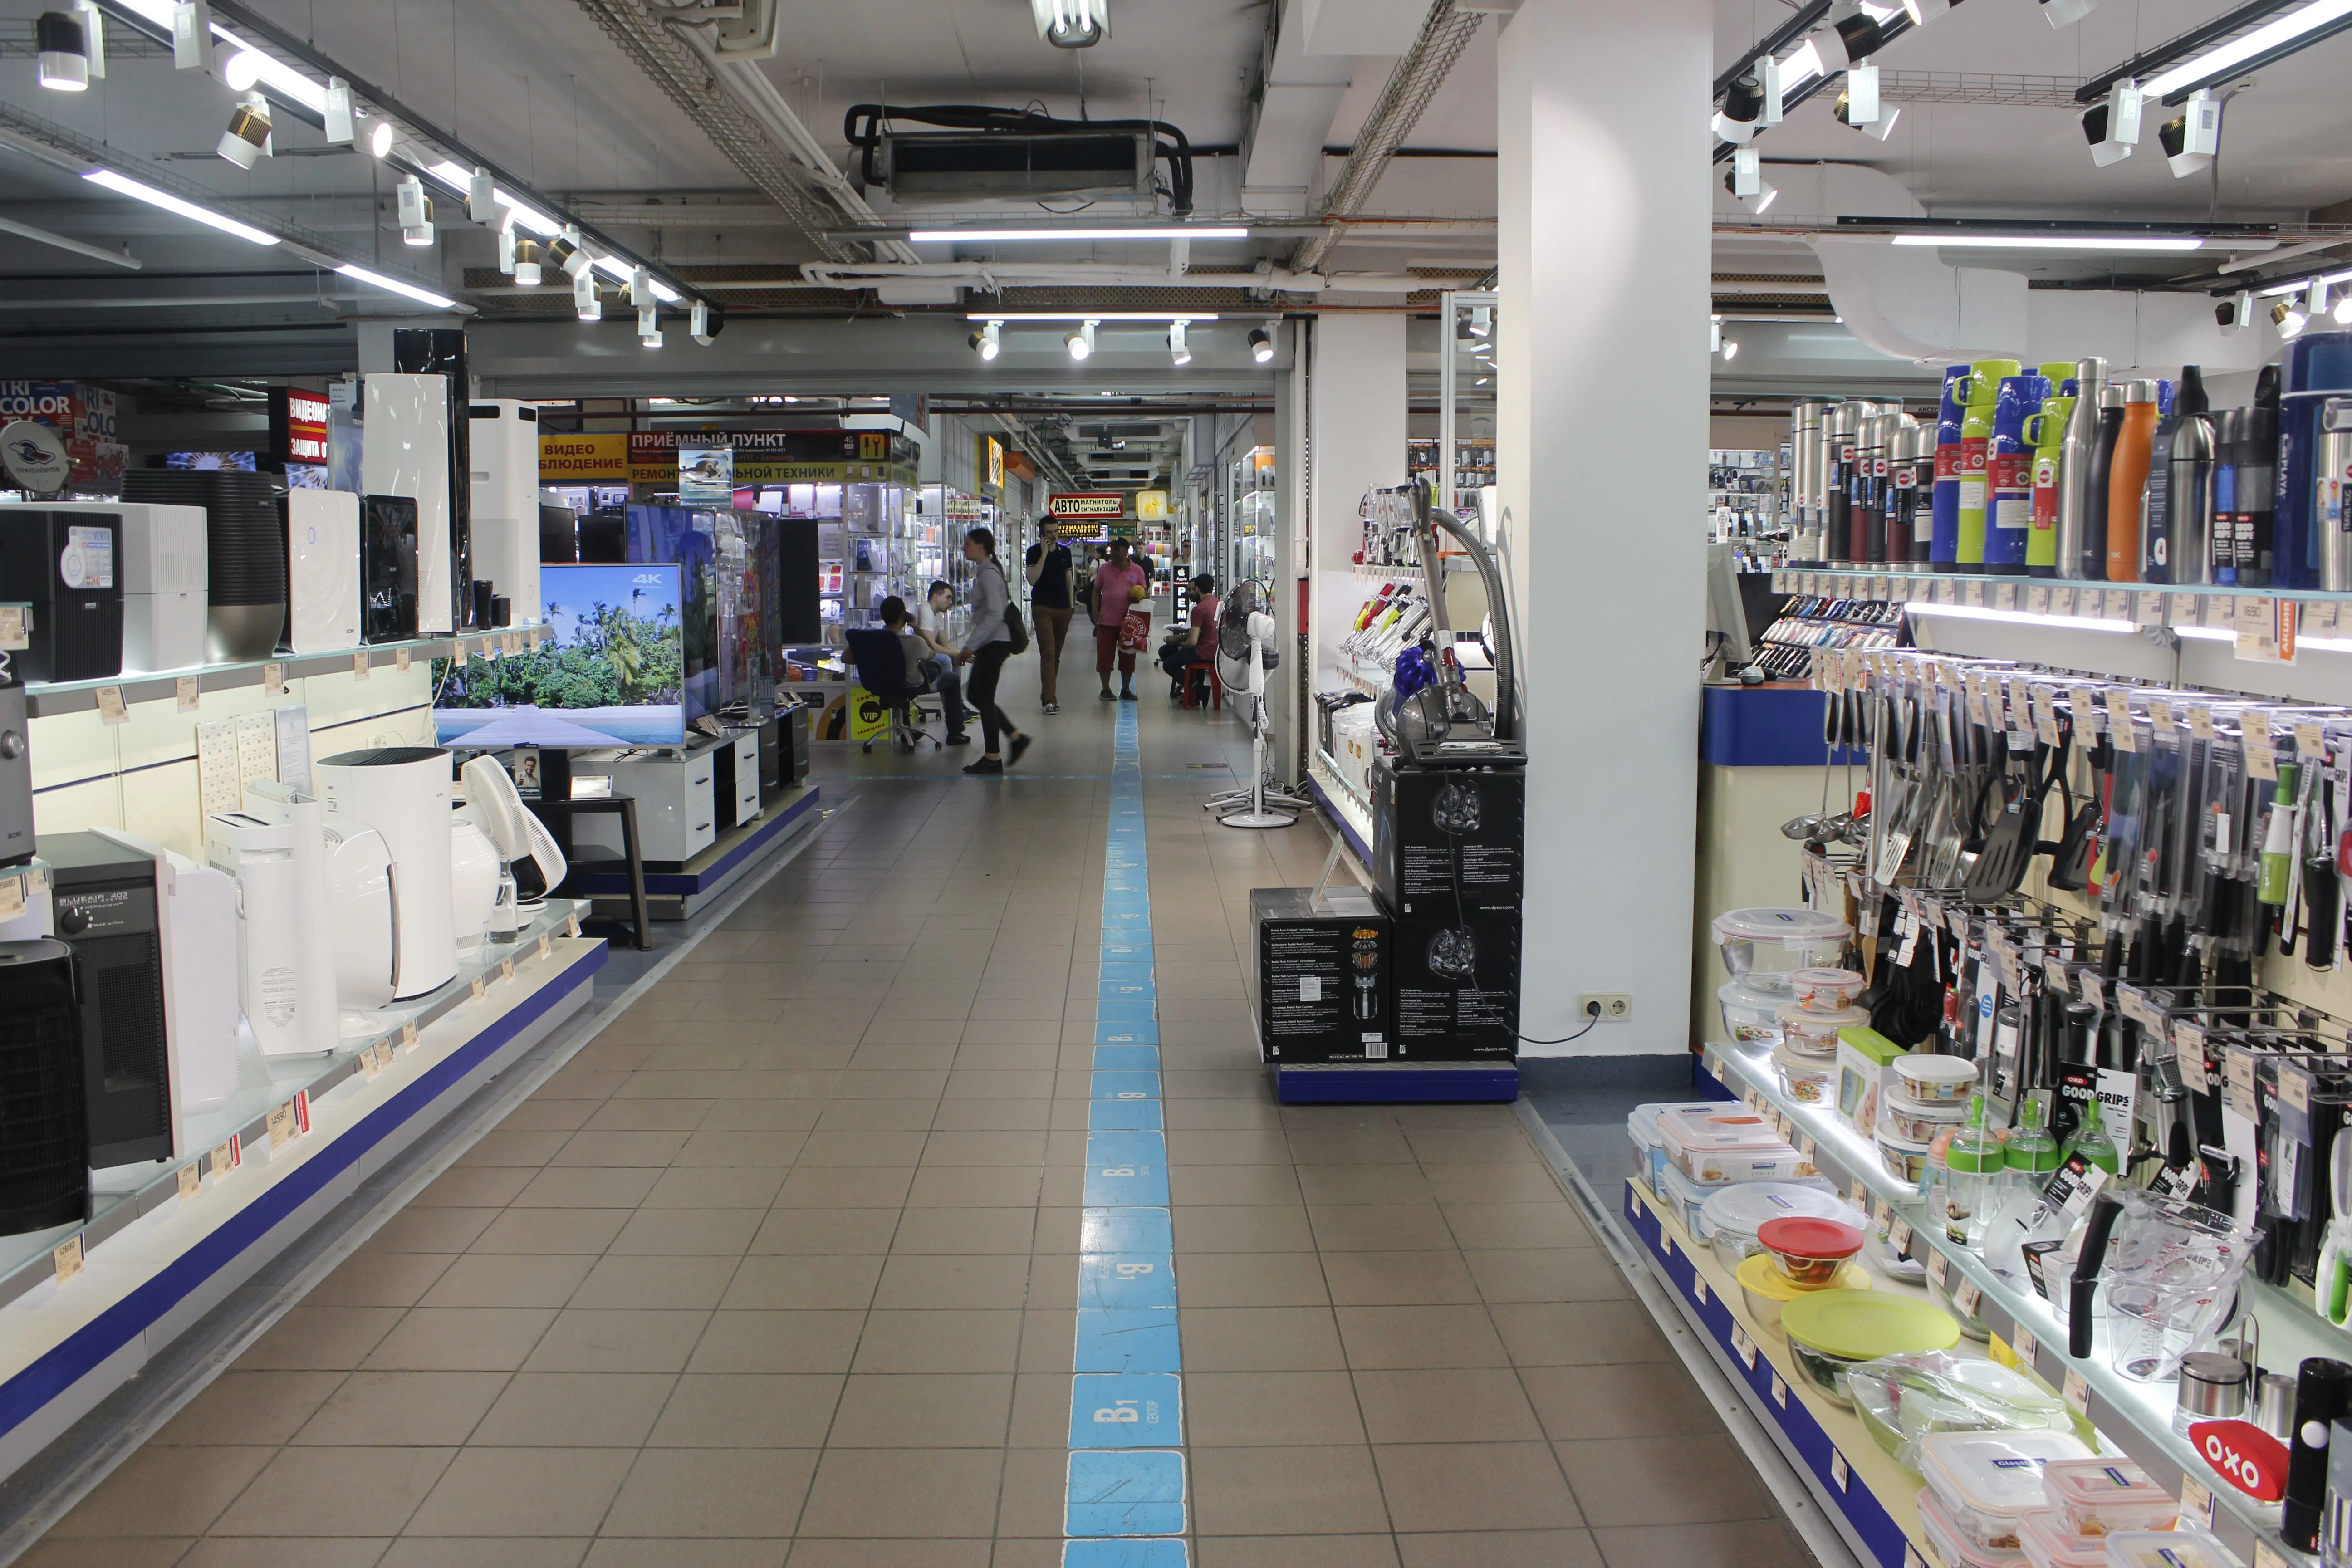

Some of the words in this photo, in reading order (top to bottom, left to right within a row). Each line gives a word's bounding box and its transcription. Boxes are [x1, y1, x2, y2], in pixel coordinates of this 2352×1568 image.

[1, 380, 29, 396] TRI
[0, 396, 71, 415] COLOR
[289, 397, 330, 423] ВИДЕОНА
[632, 432, 727, 447] ПРИЁМНЫЙ
[732, 434, 786, 446] ПУНКТ
[291, 438, 320, 458] ЗАЩИТА
[544, 444, 595, 456] ВИДЕО
[539, 458, 623, 470] БЛЮДЕНИЕ
[775, 468, 835, 478] ТЕХНИКИ
[1054, 499, 1080, 513] АВТО
[2343, 506, 2352, 531] TRAVEL
[93, 530, 110, 541] VENTA
[632, 573, 663, 584] 4K
[2282, 602, 2291, 652] АКЦИЯ
[863, 712, 878, 720] VIP
[60, 894, 105, 903] BLUEAIR
[1968, 947, 1981, 961] GOOD
[2063, 1085, 2095, 1099] GOOD
[2096, 1091, 2129, 1107] GRIPS
[2071, 1162, 2081, 1171] OXO
[2060, 1168, 2079, 1189] GOOD
[2077, 1177, 2093, 1196] GRIPS
[2161, 1166, 2179, 1186] GOOD
[2176, 1174, 2191, 1193] GRIPS
[1147, 1400, 1159, 1424] СЕКТОР
[1998, 1459, 2045, 1467] Glasslk
[2205, 1435, 2260, 1489] OXO
